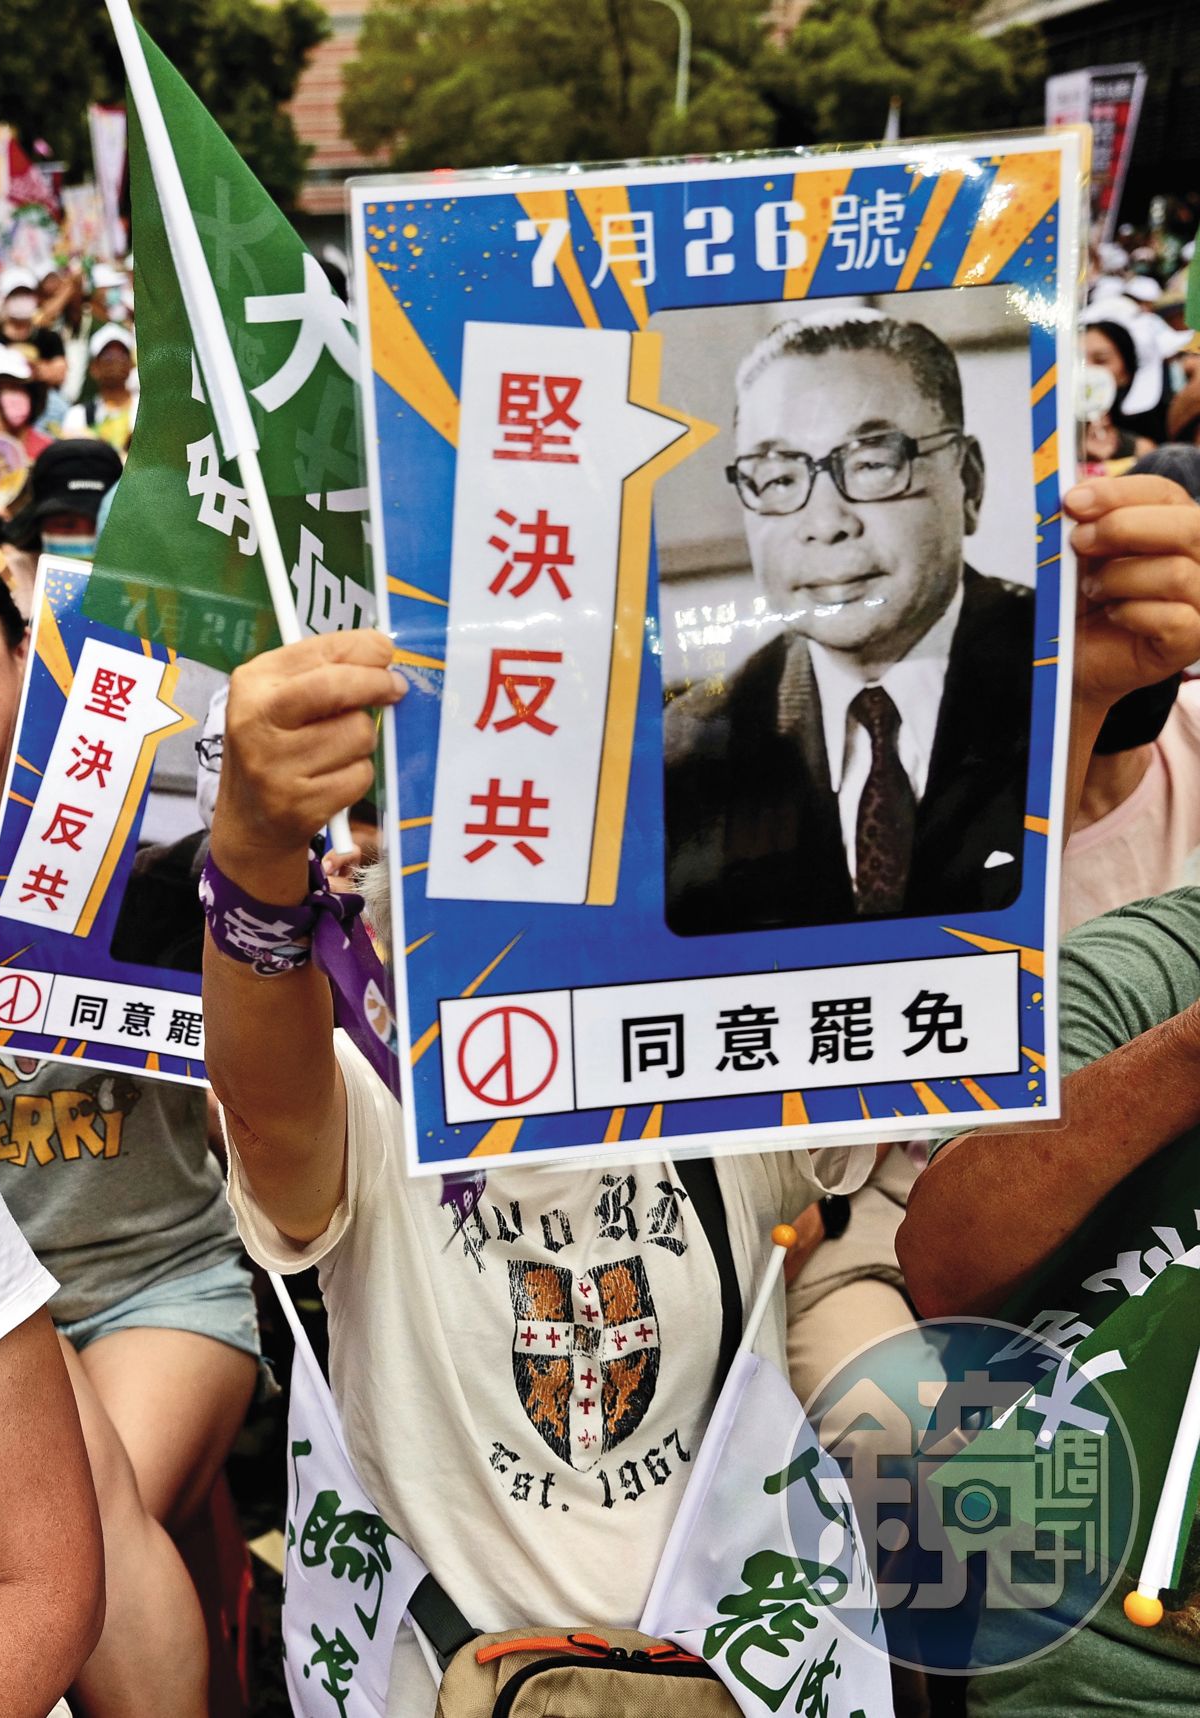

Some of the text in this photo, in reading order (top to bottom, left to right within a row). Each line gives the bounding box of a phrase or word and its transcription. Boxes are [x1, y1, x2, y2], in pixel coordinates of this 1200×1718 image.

[515, 188, 907, 289] 7月26號
[463, 371, 583, 867] 堅決反共
[21, 667, 137, 912] 堅決反共
[69, 993, 203, 1047] 同意罷
[621, 989, 969, 1083] 同意罷免
[596, 1428, 691, 1509] 1967
